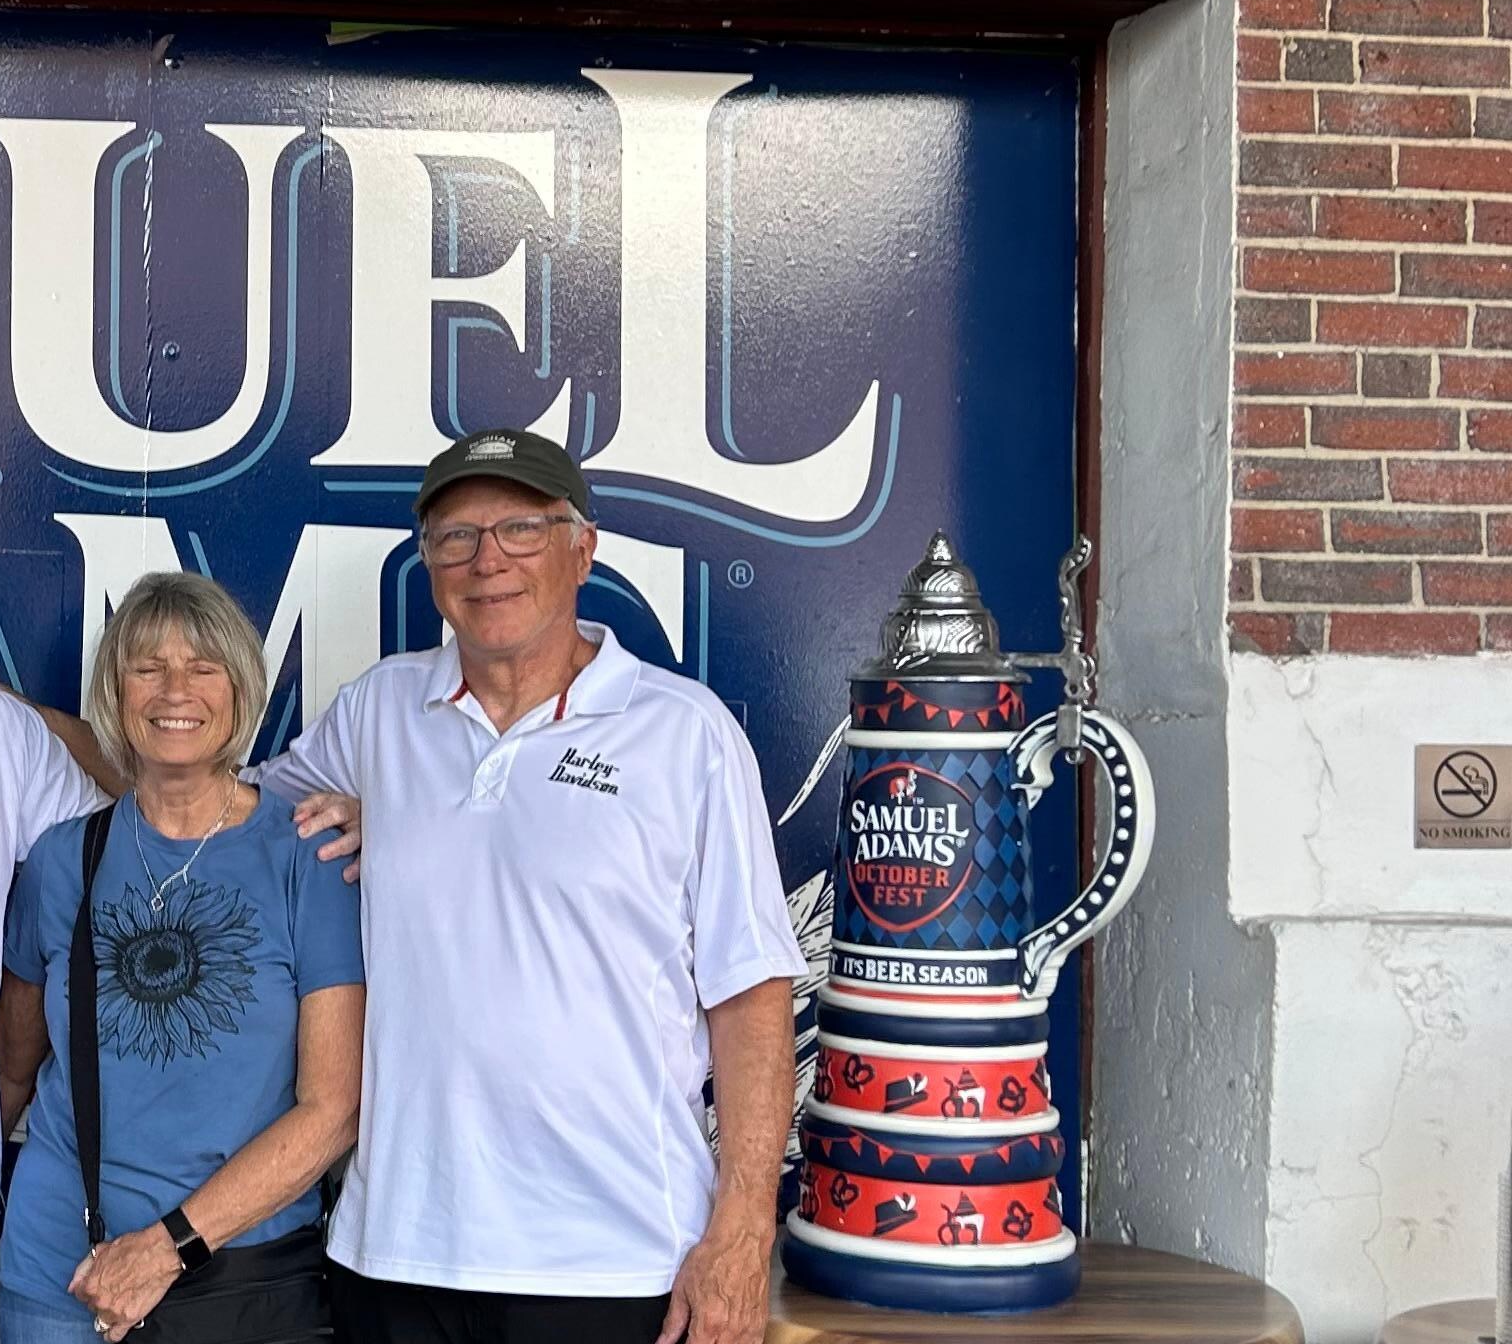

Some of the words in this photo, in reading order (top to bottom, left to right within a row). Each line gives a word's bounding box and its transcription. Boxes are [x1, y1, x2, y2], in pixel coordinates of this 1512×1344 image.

[548, 764, 619, 796] Davidson
[851, 799, 969, 838] SAMUEL
[1419, 827, 1440, 838] NO
[1443, 827, 1511, 839] SMOKING
[854, 833, 956, 867] ADAMS
[854, 863, 950, 888] OCTOBER
[873, 885, 928, 907] FEST
[865, 958, 916, 983] BEER
[918, 965, 988, 985] SEASON
